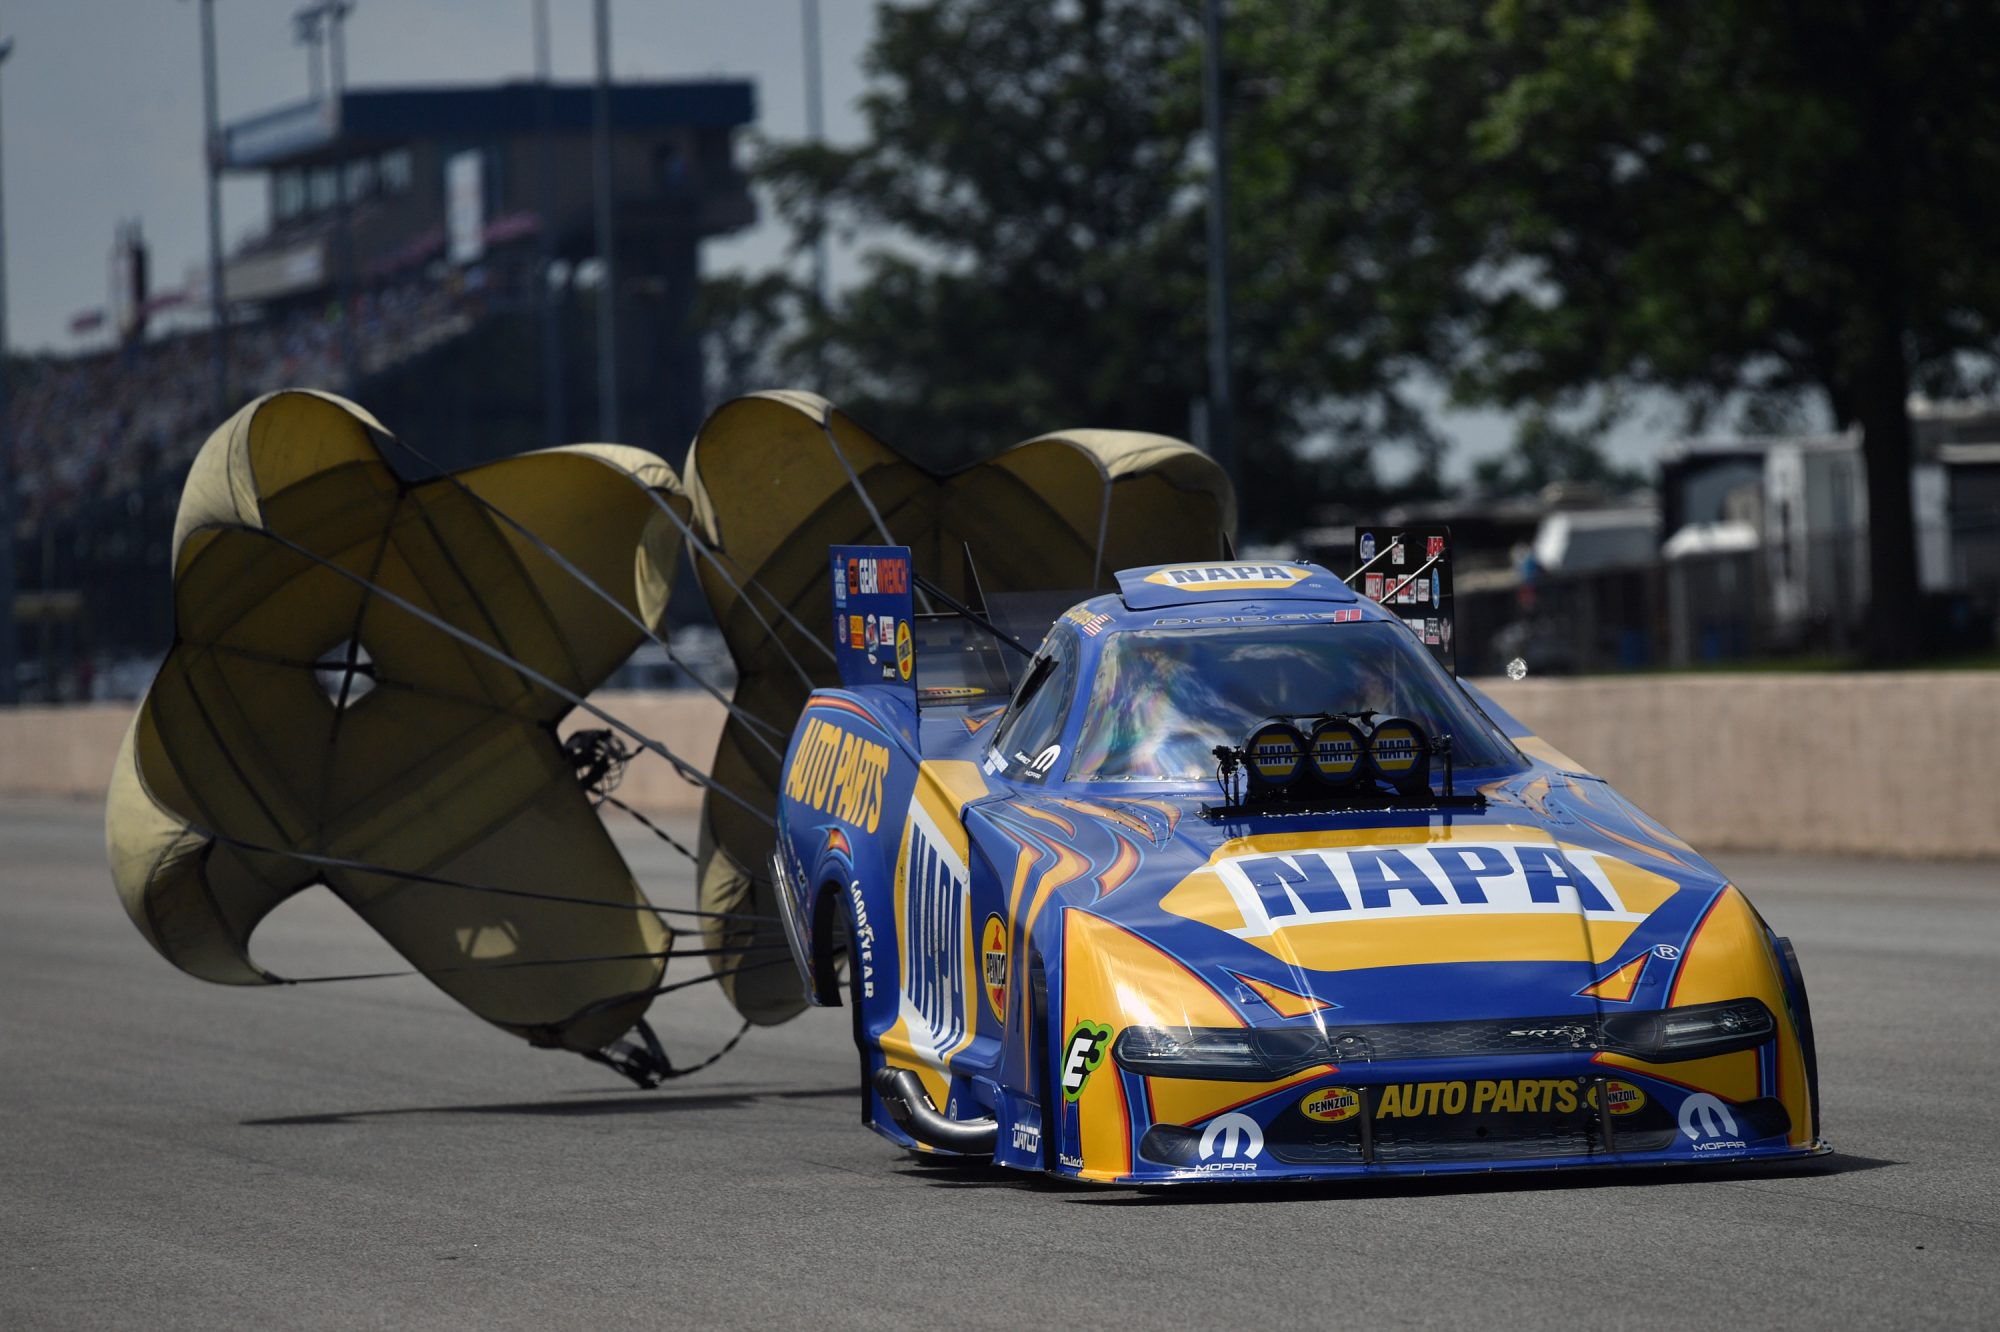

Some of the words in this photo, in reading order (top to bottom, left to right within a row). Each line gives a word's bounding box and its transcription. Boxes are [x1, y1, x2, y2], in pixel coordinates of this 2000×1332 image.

[858, 558, 908, 594] GEARWRENCH
[1169, 566, 1292, 584] NAPA
[1258, 744, 1294, 765] NAPA
[1318, 742, 1354, 763] NAPA
[1378, 739, 1413, 760] NAPA
[785, 717, 843, 811] AUTO
[826, 732, 890, 834] PARTS
[1237, 846, 1615, 920] NAPA
[851, 880, 875, 998] GOODYEAR
[907, 822, 964, 1062] NAPA
[1506, 1029, 1568, 1038] SRT
[1062, 1026, 1111, 1088] E3
[1308, 1096, 1356, 1114] PENNZOIL
[1376, 1080, 1467, 1119] AUTO
[1472, 1078, 1578, 1114] PARTS
[1595, 1090, 1637, 1105] NNZOIL
[1692, 1141, 1747, 1152] MOPAR
[1195, 1162, 1258, 1172] MOPAR
